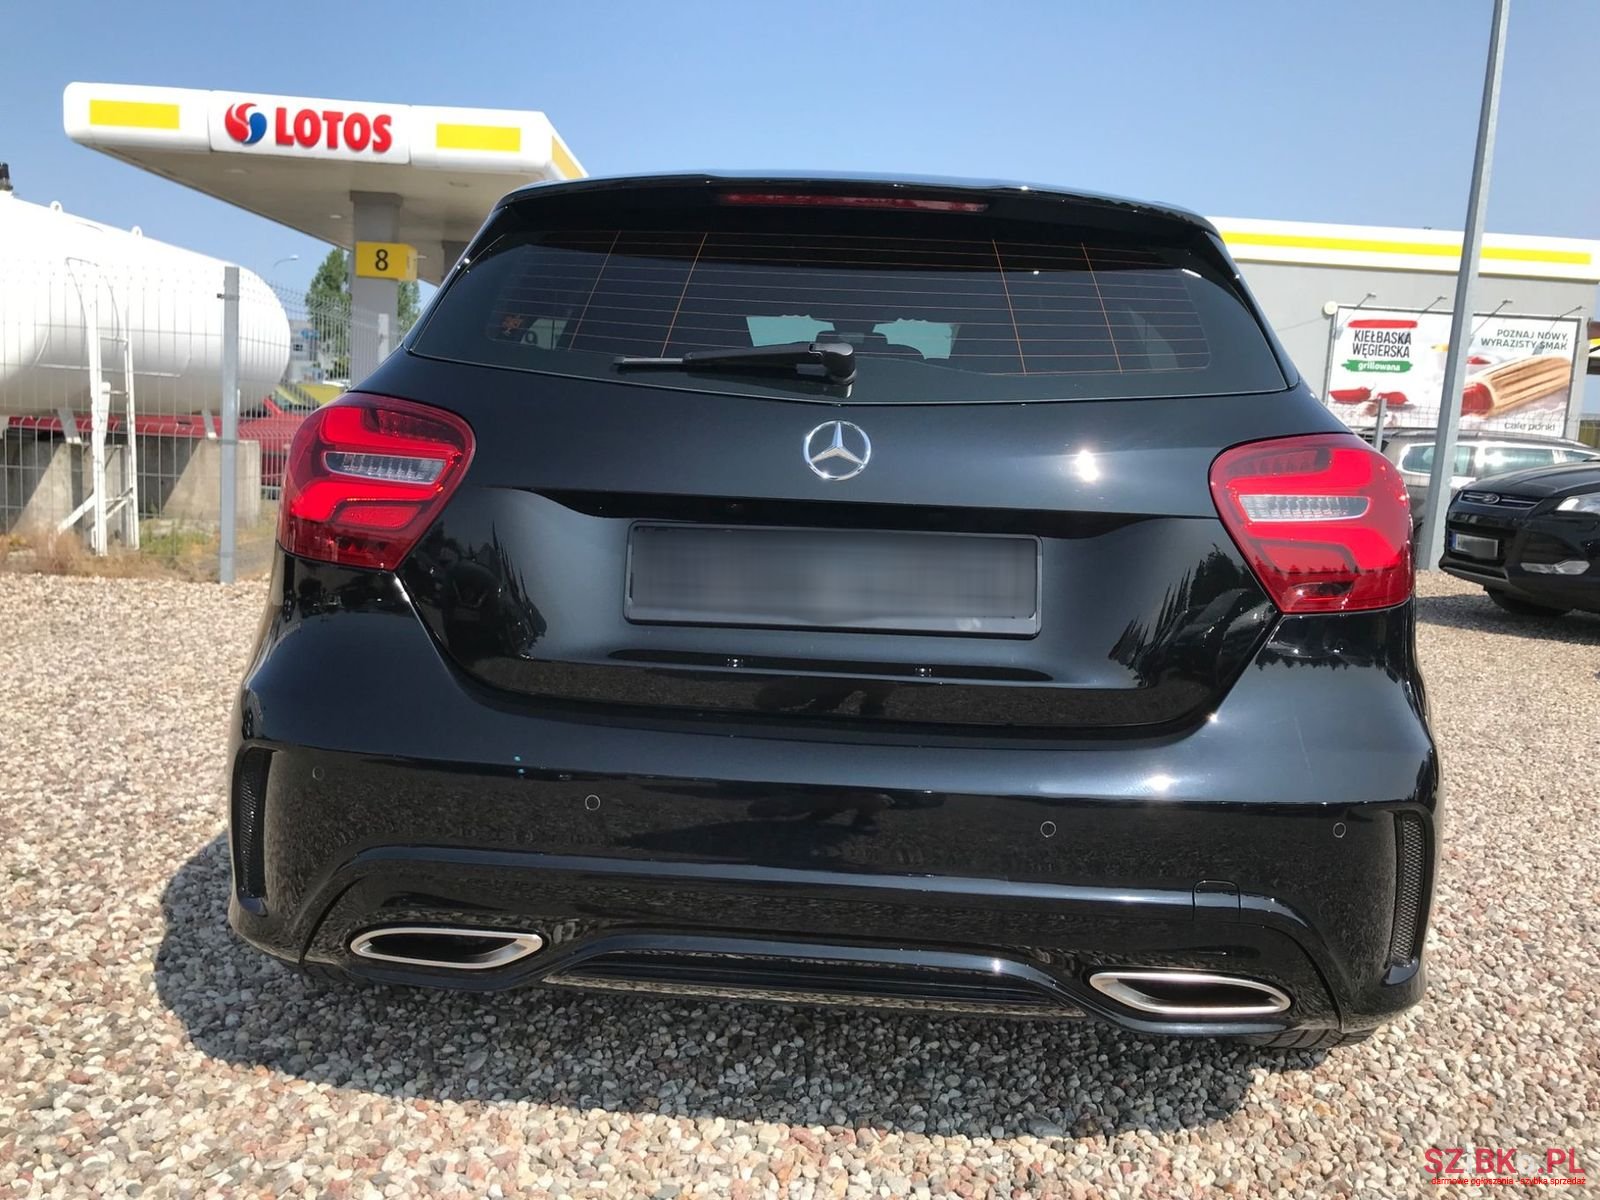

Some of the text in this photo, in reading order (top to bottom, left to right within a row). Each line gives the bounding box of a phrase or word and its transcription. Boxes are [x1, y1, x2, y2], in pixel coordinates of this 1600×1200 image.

[275, 107, 392, 154] LOTOS
[375, 248, 388, 271] 8
[1354, 329, 1412, 345] KIEŁBASKA
[1497, 329, 1535, 339] POZNAJ
[1352, 342, 1410, 358] WĘGIERSKA
[1481, 338, 1568, 350] WYRAZISTY SMAK
[1358, 361, 1401, 372] grillowana
